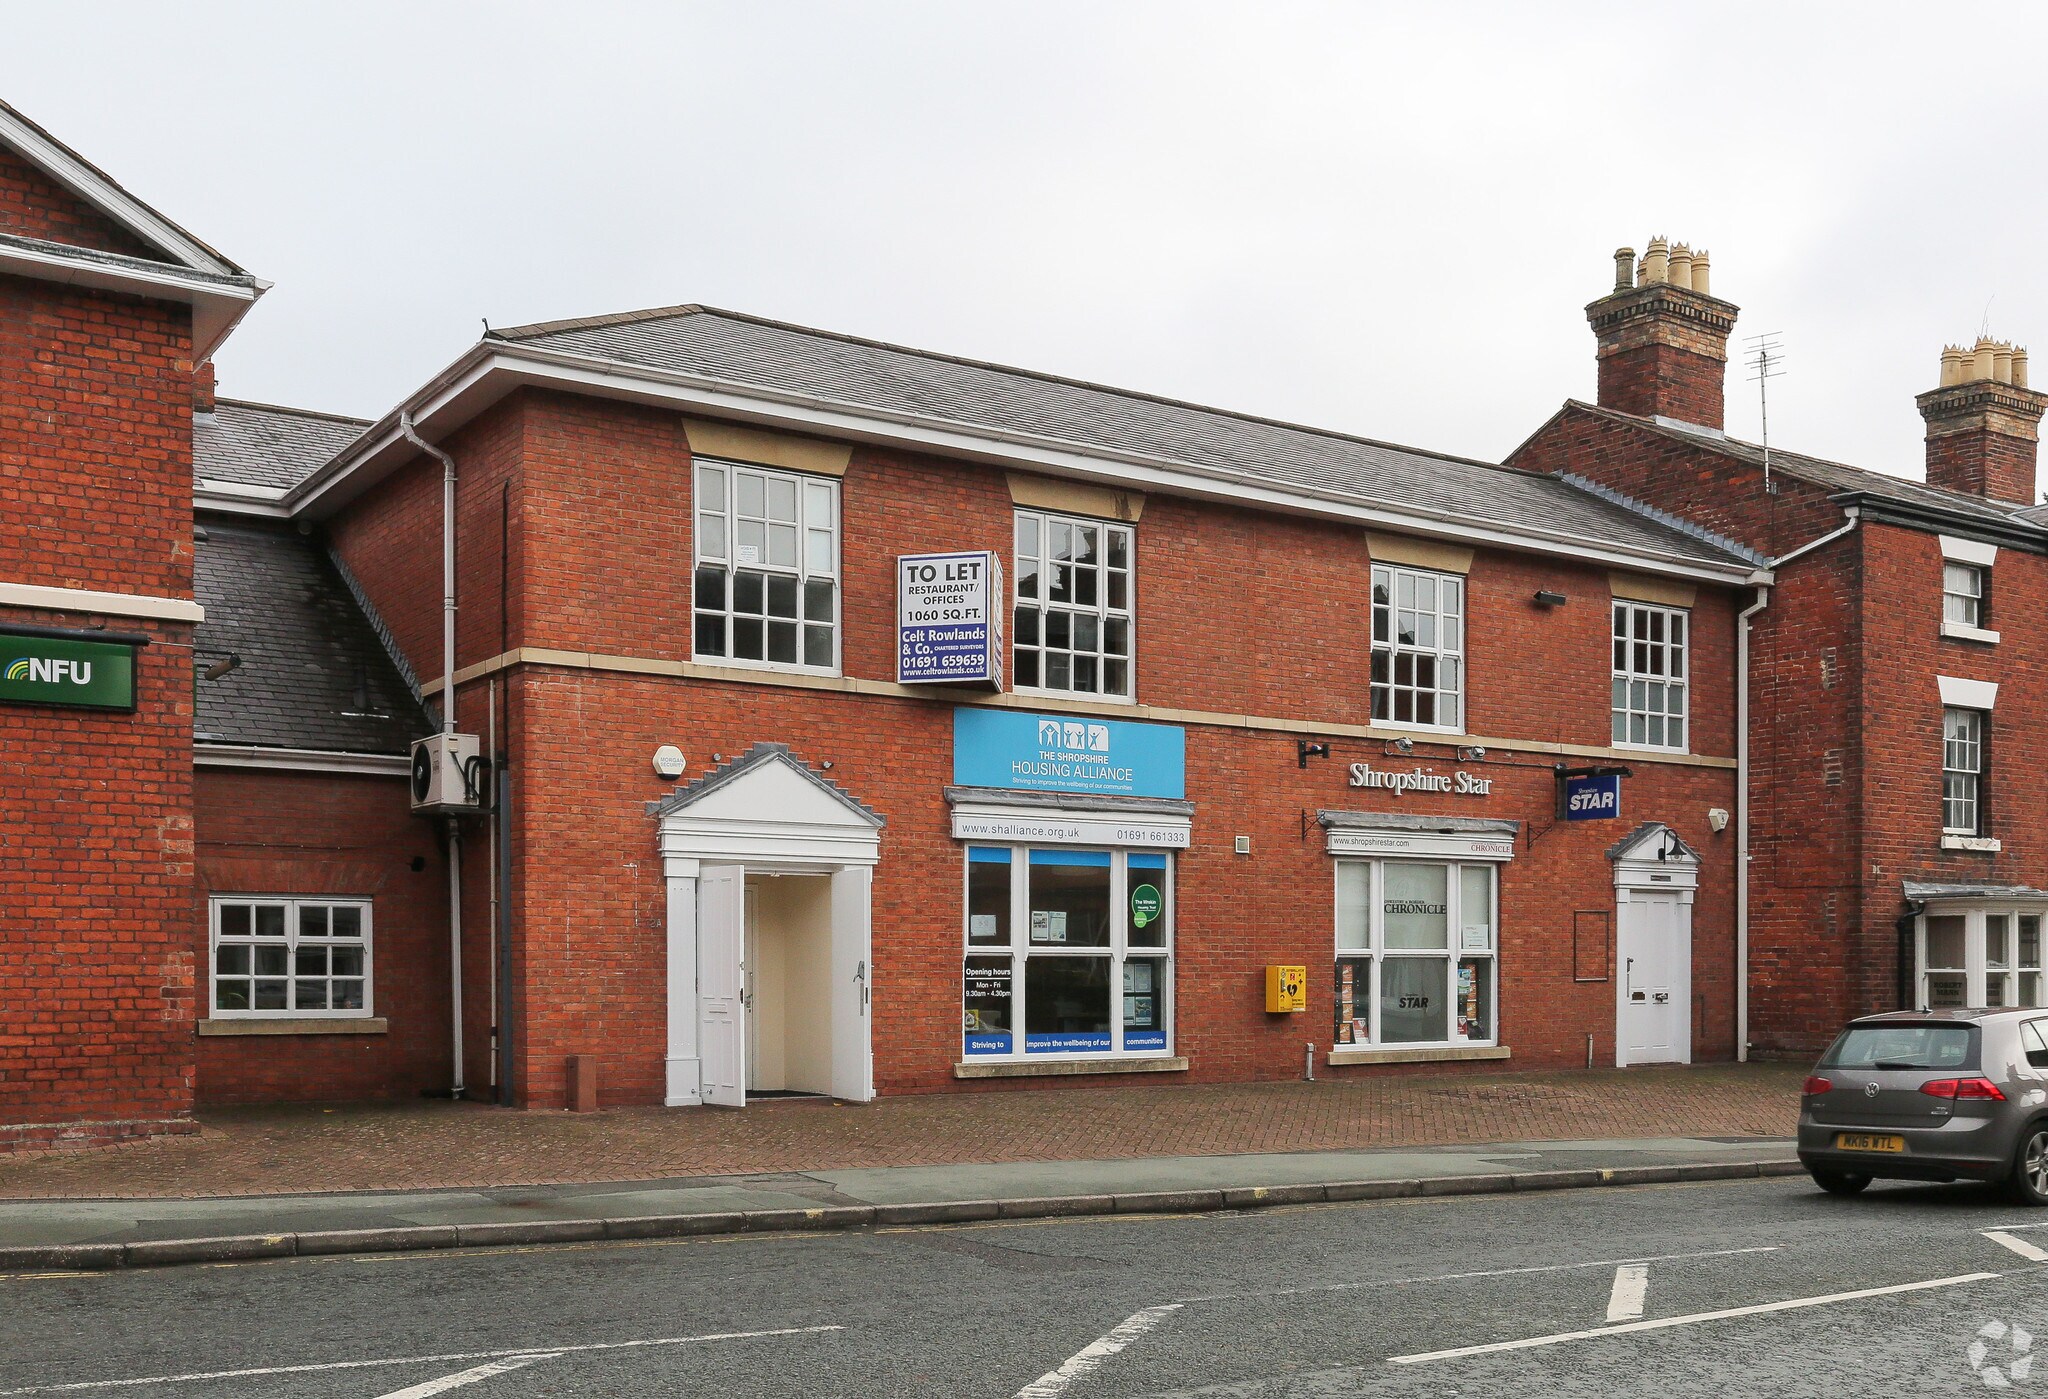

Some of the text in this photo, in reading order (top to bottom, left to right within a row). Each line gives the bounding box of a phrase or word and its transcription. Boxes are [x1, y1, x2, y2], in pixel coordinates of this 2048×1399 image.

[907, 563, 980, 582] TO LET
[908, 583, 980, 595] RESTAURANT/
[924, 595, 964, 605] OFFICES
[908, 608, 980, 621] 1060 SQ.FT.
[902, 627, 985, 642] Celt Rowlands
[902, 644, 911, 655] &
[915, 643, 933, 654] Co.
[903, 654, 984, 668] 01691 659659
[30, 658, 91, 684] NFU
[903, 666, 984, 676] www.celtrowlands.co.uk
[1039, 751, 1108, 764] THE SHROPSHIRE
[1012, 761, 1133, 781] HOUSING ALLIANCE
[1013, 777, 1031, 785] Striving
[1350, 763, 1492, 796] Shropshire Star
[1570, 792, 1614, 810] STAR
[962, 824, 1184, 842] www.shalliance.org.uk 01691 661333
[1333, 837, 1410, 847] www.shropshirestar.com
[1471, 844, 1510, 852] CHRONICLE
[1384, 904, 1447, 914] CHRONICLE
[966, 968, 992, 976] Opening
[1399, 997, 1428, 1008] STAR
[972, 1041, 996, 1049] Striving
[1026, 1041, 1051, 1049] improve
[1844, 1136, 1895, 1149] MK16 WTL
